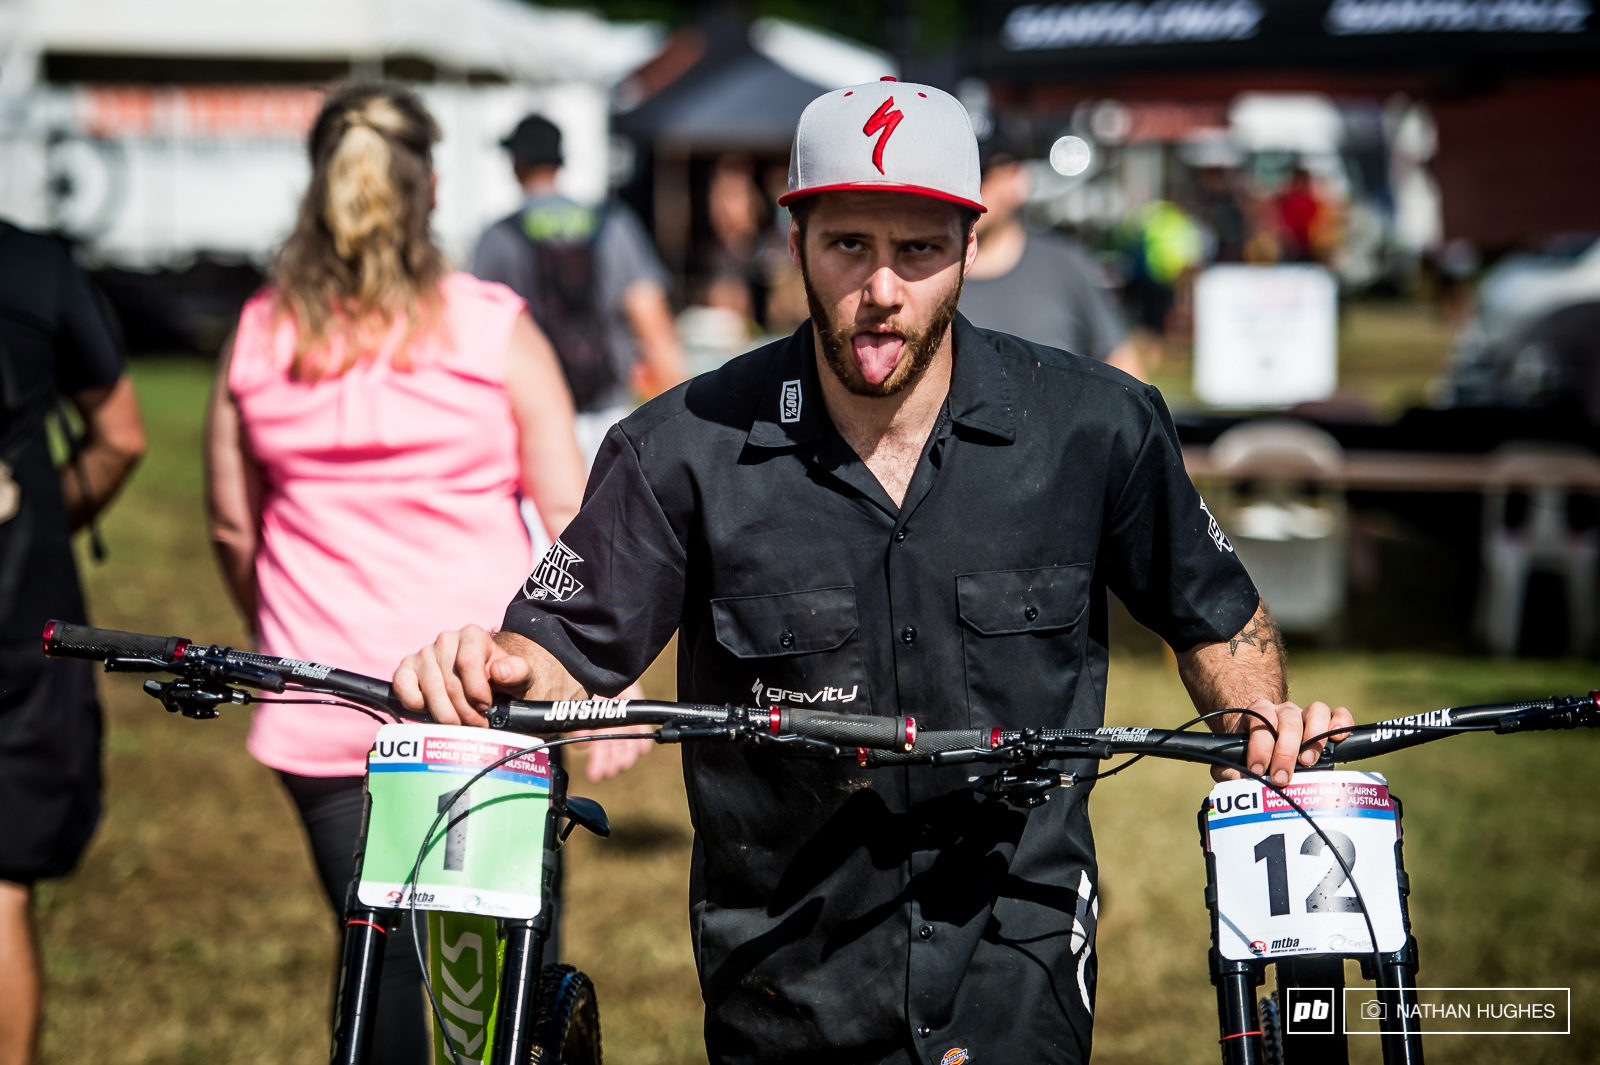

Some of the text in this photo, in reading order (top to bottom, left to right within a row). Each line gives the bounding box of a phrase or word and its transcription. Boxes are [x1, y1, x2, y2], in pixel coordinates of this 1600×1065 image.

[785, 386, 797, 417] 100%
[278, 658, 333, 674] ANALOG
[291, 667, 328, 680] CARBON
[766, 685, 858, 703] gravity
[544, 699, 630, 721] JOYSTICK
[1095, 726, 1151, 735] ANALOG
[1370, 708, 1452, 743] JOYSTICK
[1110, 734, 1147, 743] CARBON
[380, 741, 418, 758] UCI
[426, 740, 477, 753] MOUNTAIN
[425, 750, 460, 760] WORLD
[504, 760, 547, 775] AUSTRALIA
[1266, 786, 1317, 799] MUNTAIN
[1347, 786, 1378, 797] CAIRNS
[1216, 792, 1258, 814] UCI
[1302, 796, 1322, 805] CUP
[1347, 796, 1390, 808] AUSTRALIA
[438, 788, 471, 871] 1
[1253, 829, 1365, 917] 12
[1270, 937, 1300, 950] mtba
